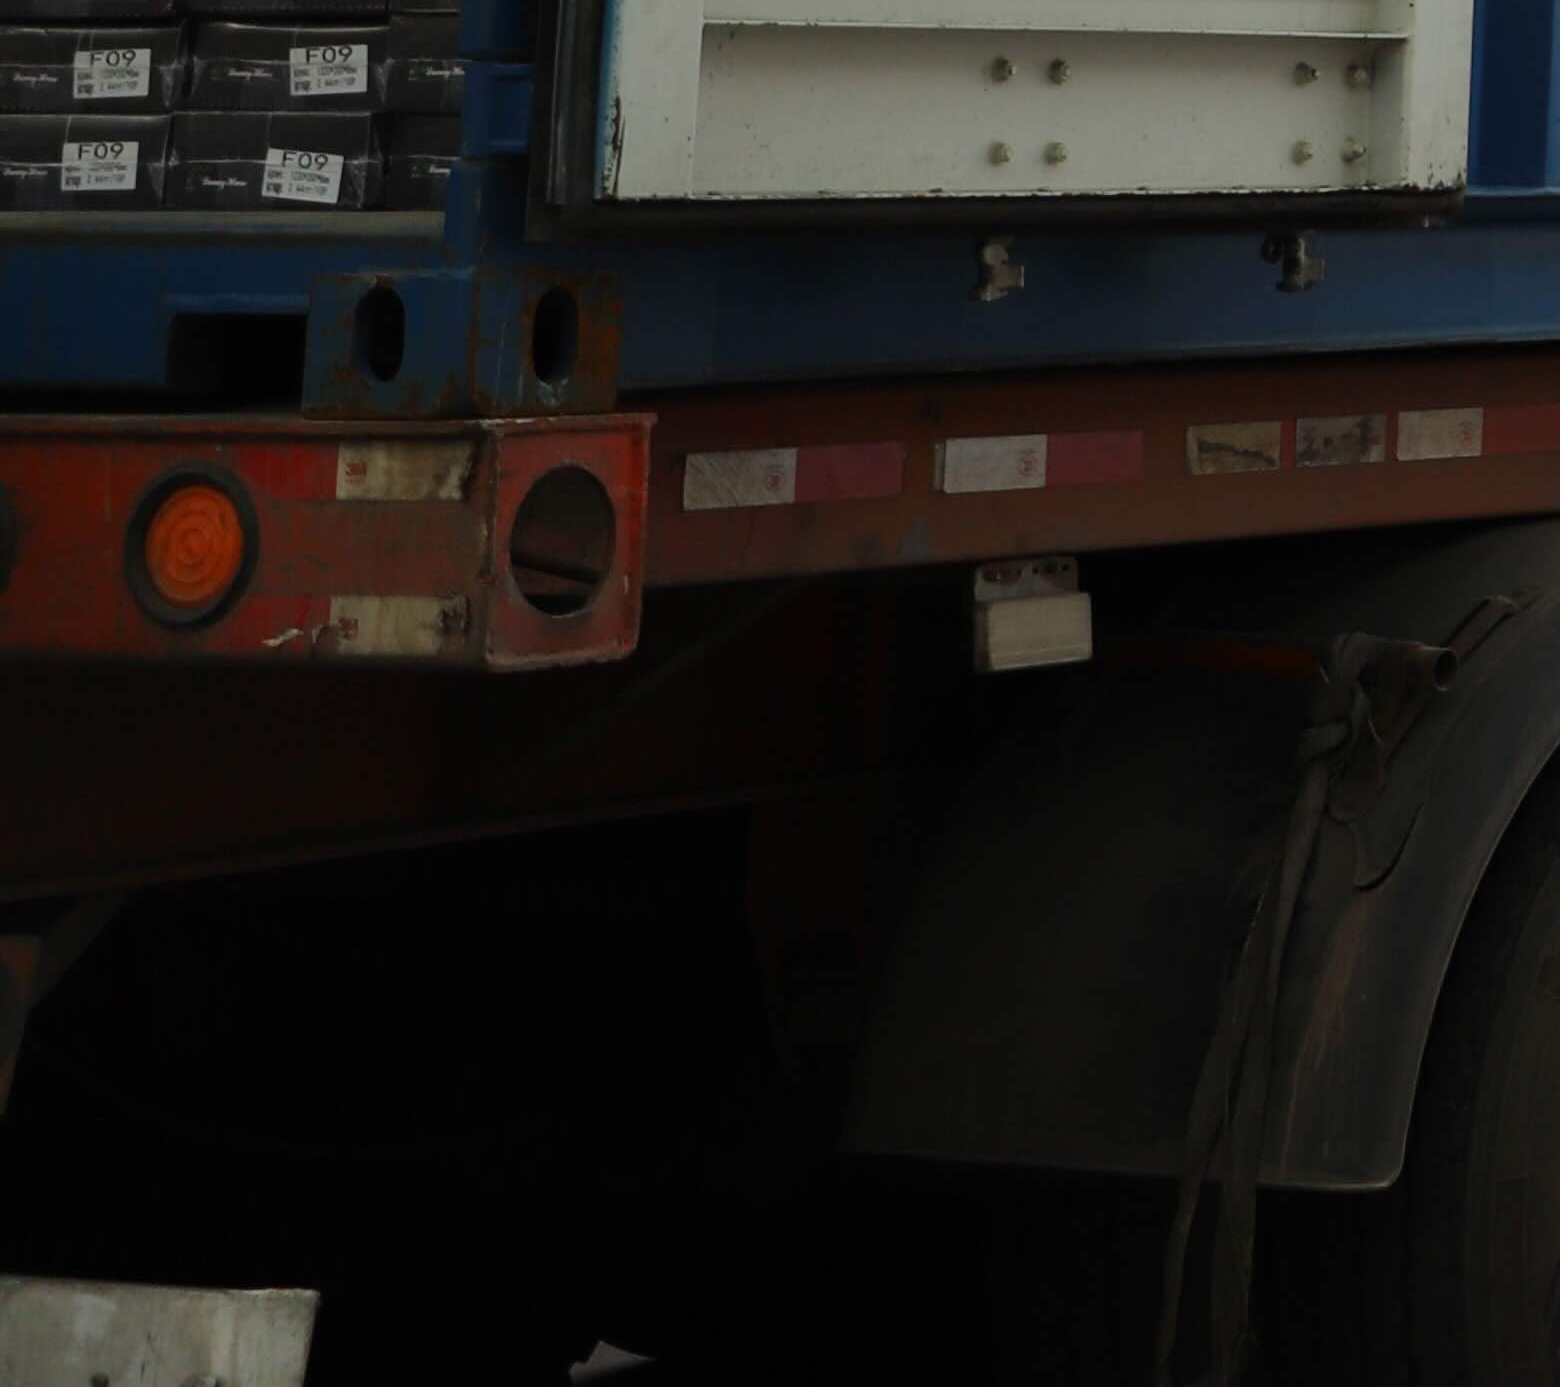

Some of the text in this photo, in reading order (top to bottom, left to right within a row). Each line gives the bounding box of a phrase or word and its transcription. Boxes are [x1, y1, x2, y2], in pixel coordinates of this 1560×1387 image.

[89, 50, 136, 67] F09
[304, 46, 351, 64] F09
[77, 143, 124, 161] F09
[281, 151, 328, 170] F09
